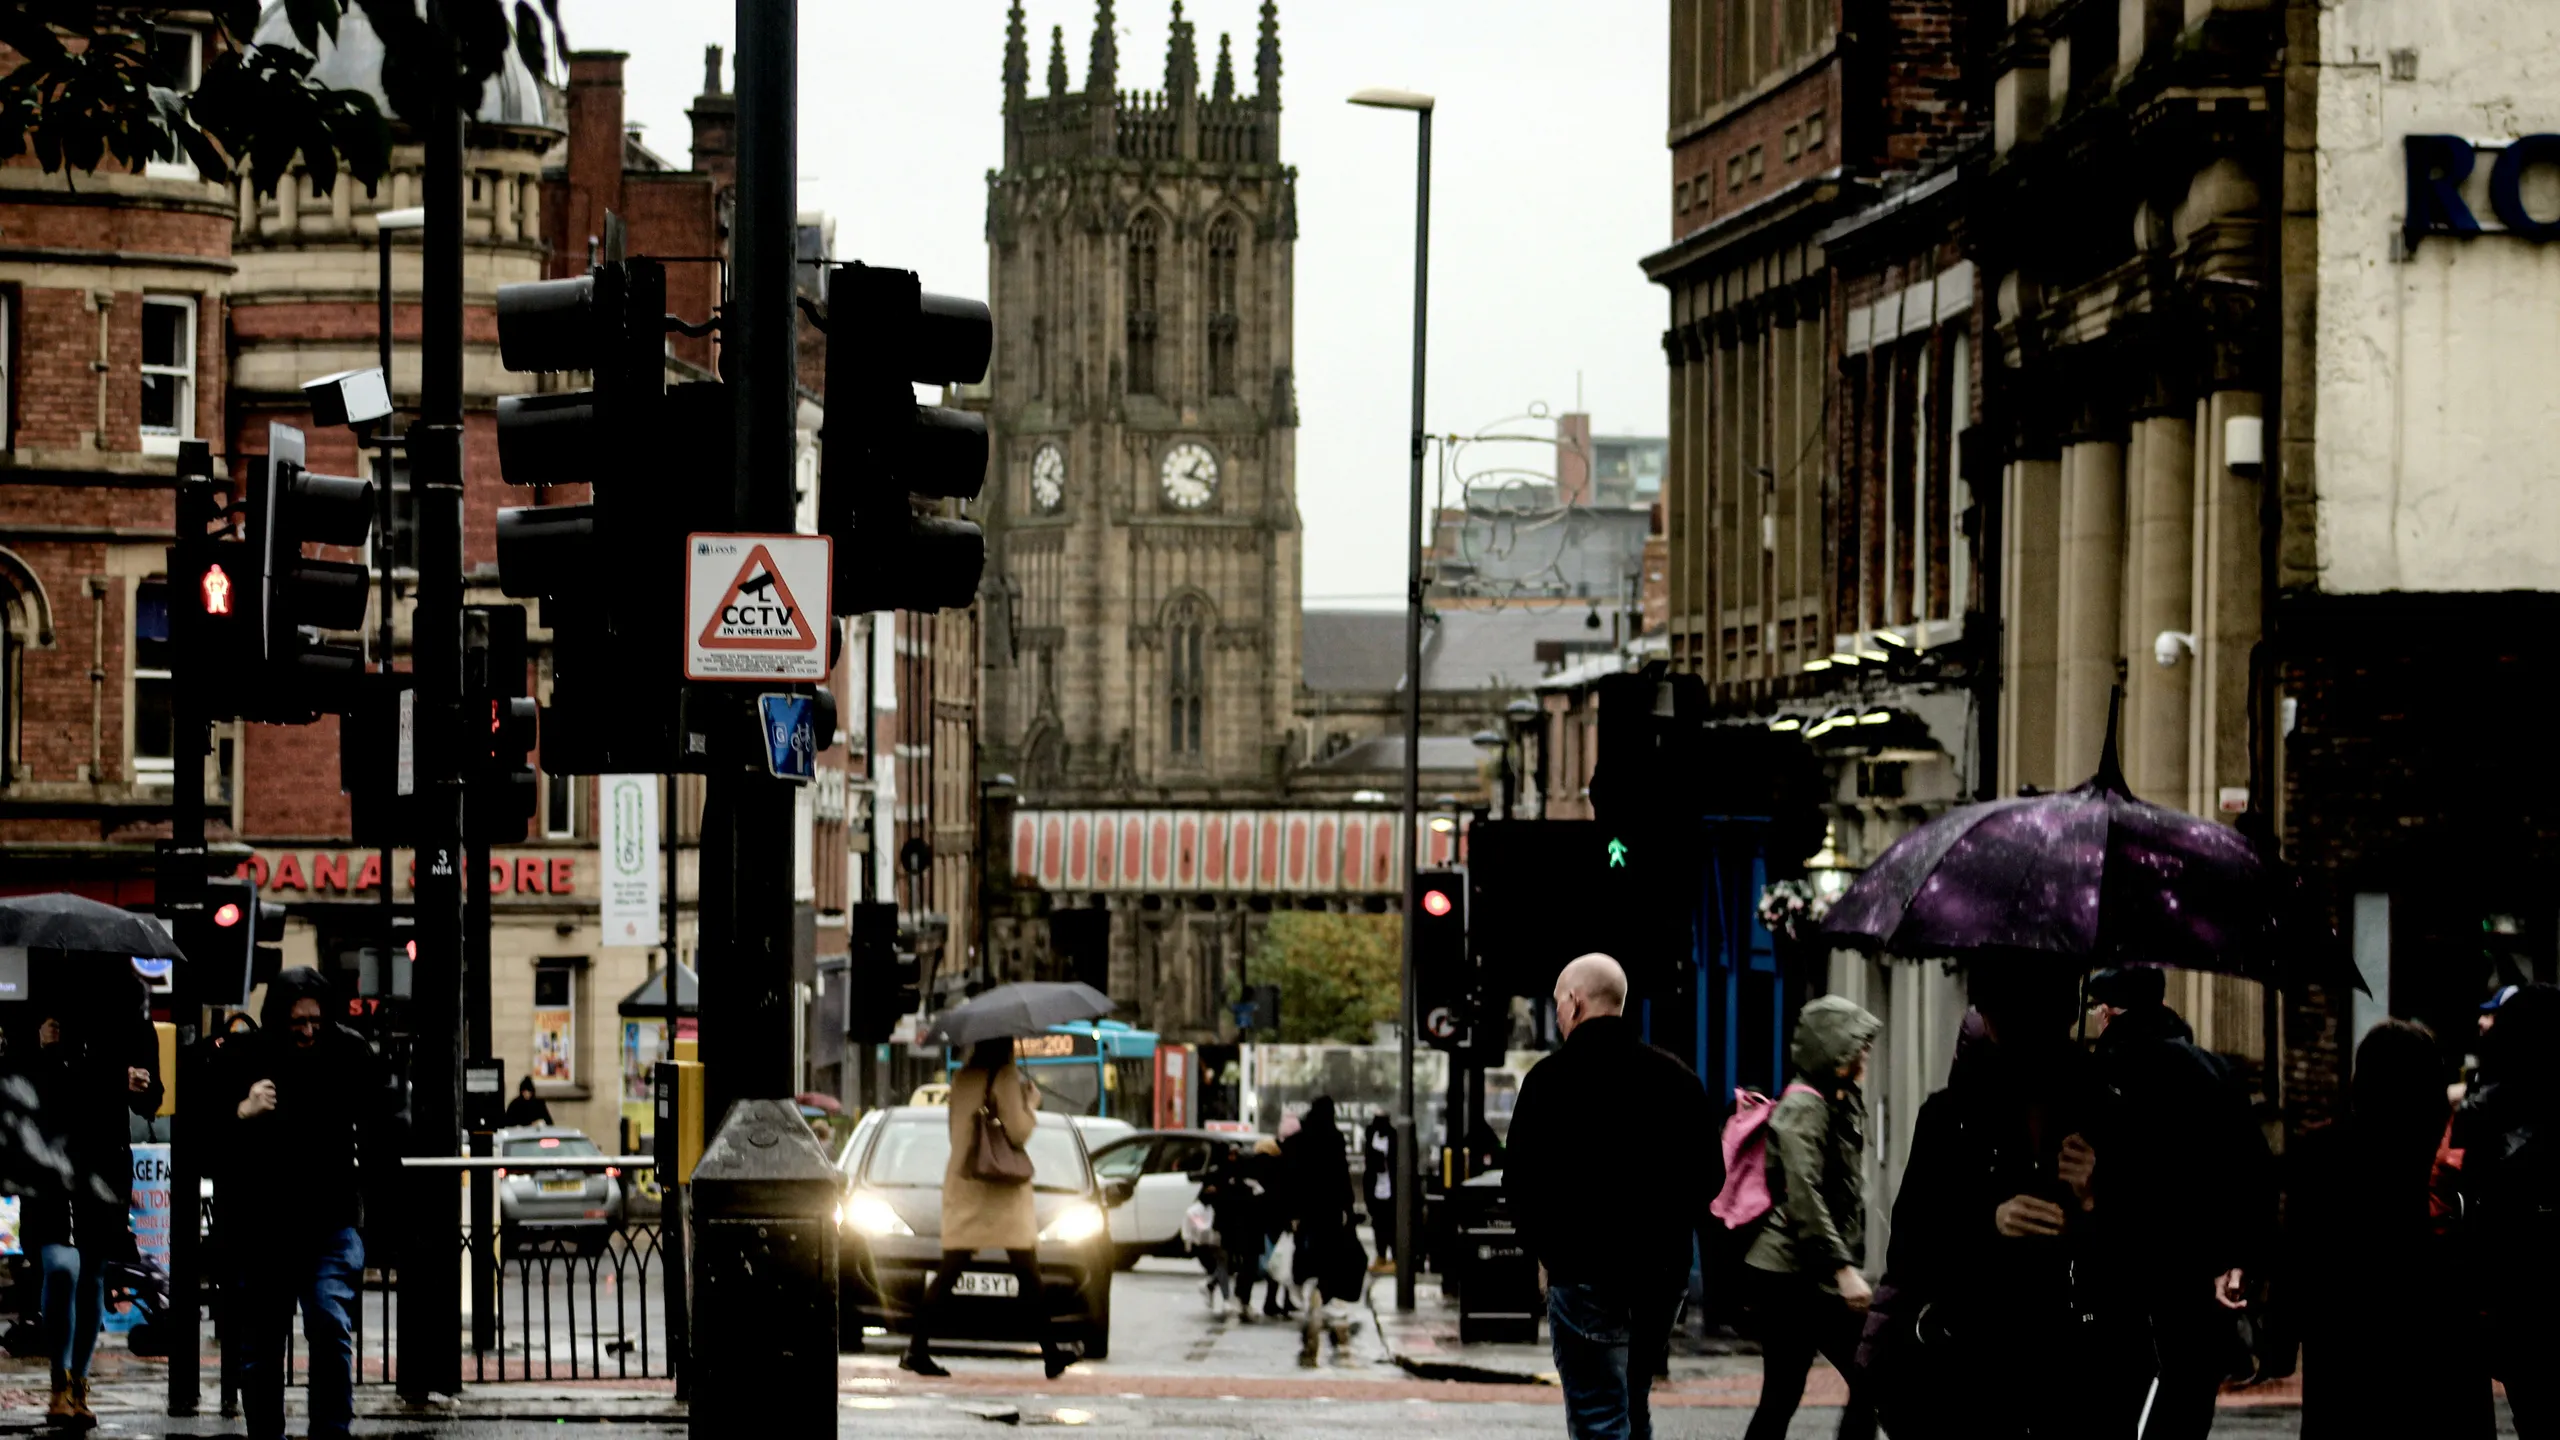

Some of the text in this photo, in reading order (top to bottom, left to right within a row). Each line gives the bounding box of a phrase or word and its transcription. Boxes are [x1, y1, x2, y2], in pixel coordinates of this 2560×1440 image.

[721, 605, 794, 626] CCTV
[722, 627, 793, 637] IN OPERATION
[438, 849, 448, 866] 3
[980, 1277, 1013, 1293] SYT
